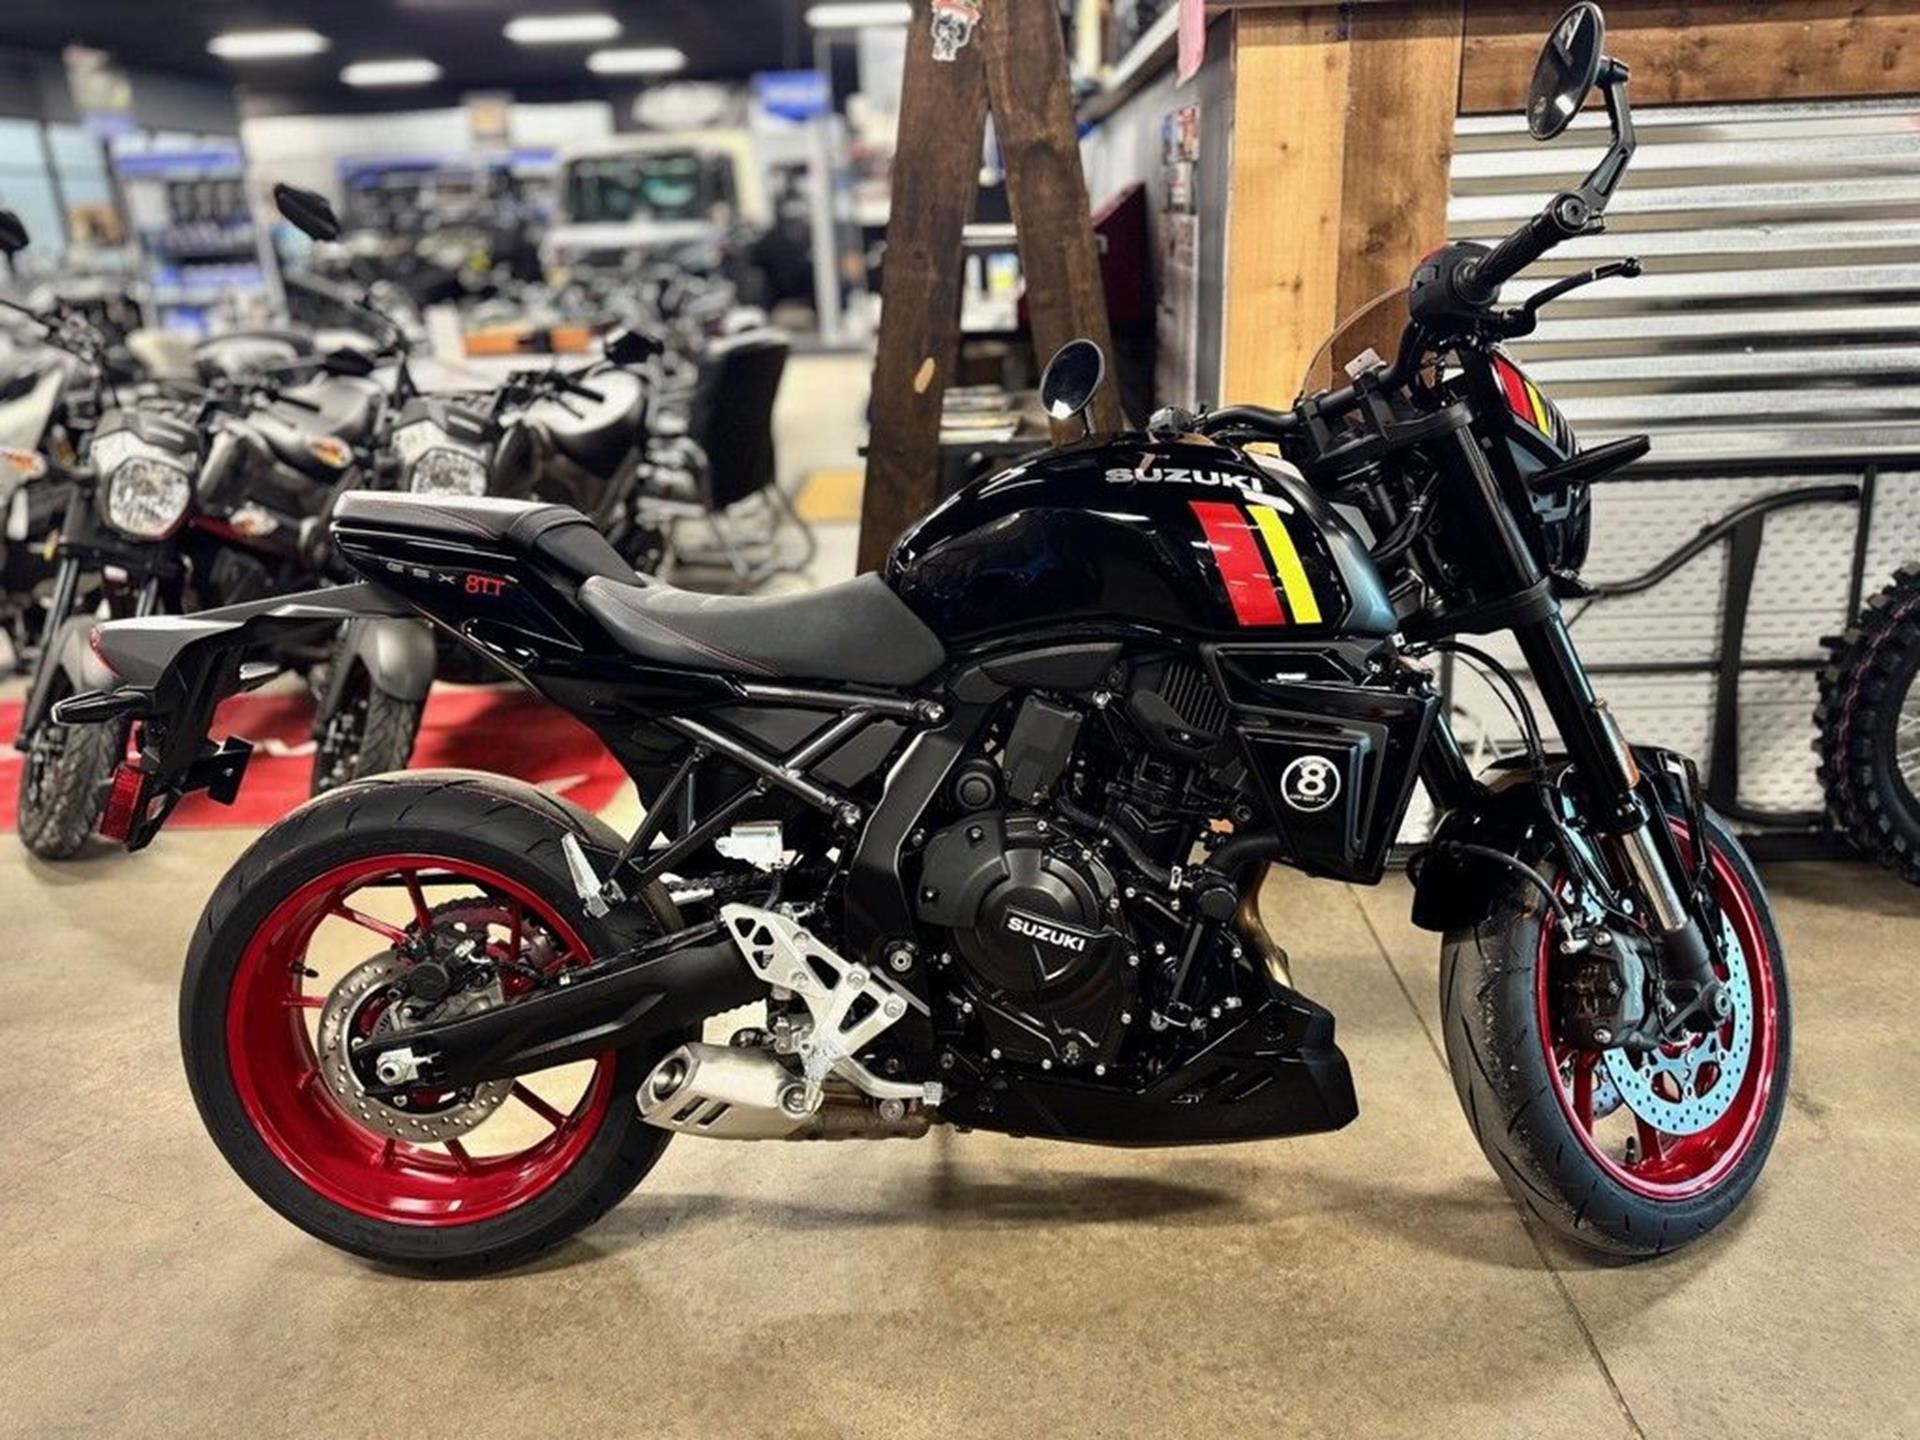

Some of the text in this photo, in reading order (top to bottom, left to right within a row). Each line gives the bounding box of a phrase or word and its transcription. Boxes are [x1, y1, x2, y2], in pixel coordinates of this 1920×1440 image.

[1105, 468, 1263, 492] SUZUKI
[464, 573, 506, 597] 8TT
[1297, 762, 1326, 796] 8
[1007, 917, 1085, 951] SUZUKI
